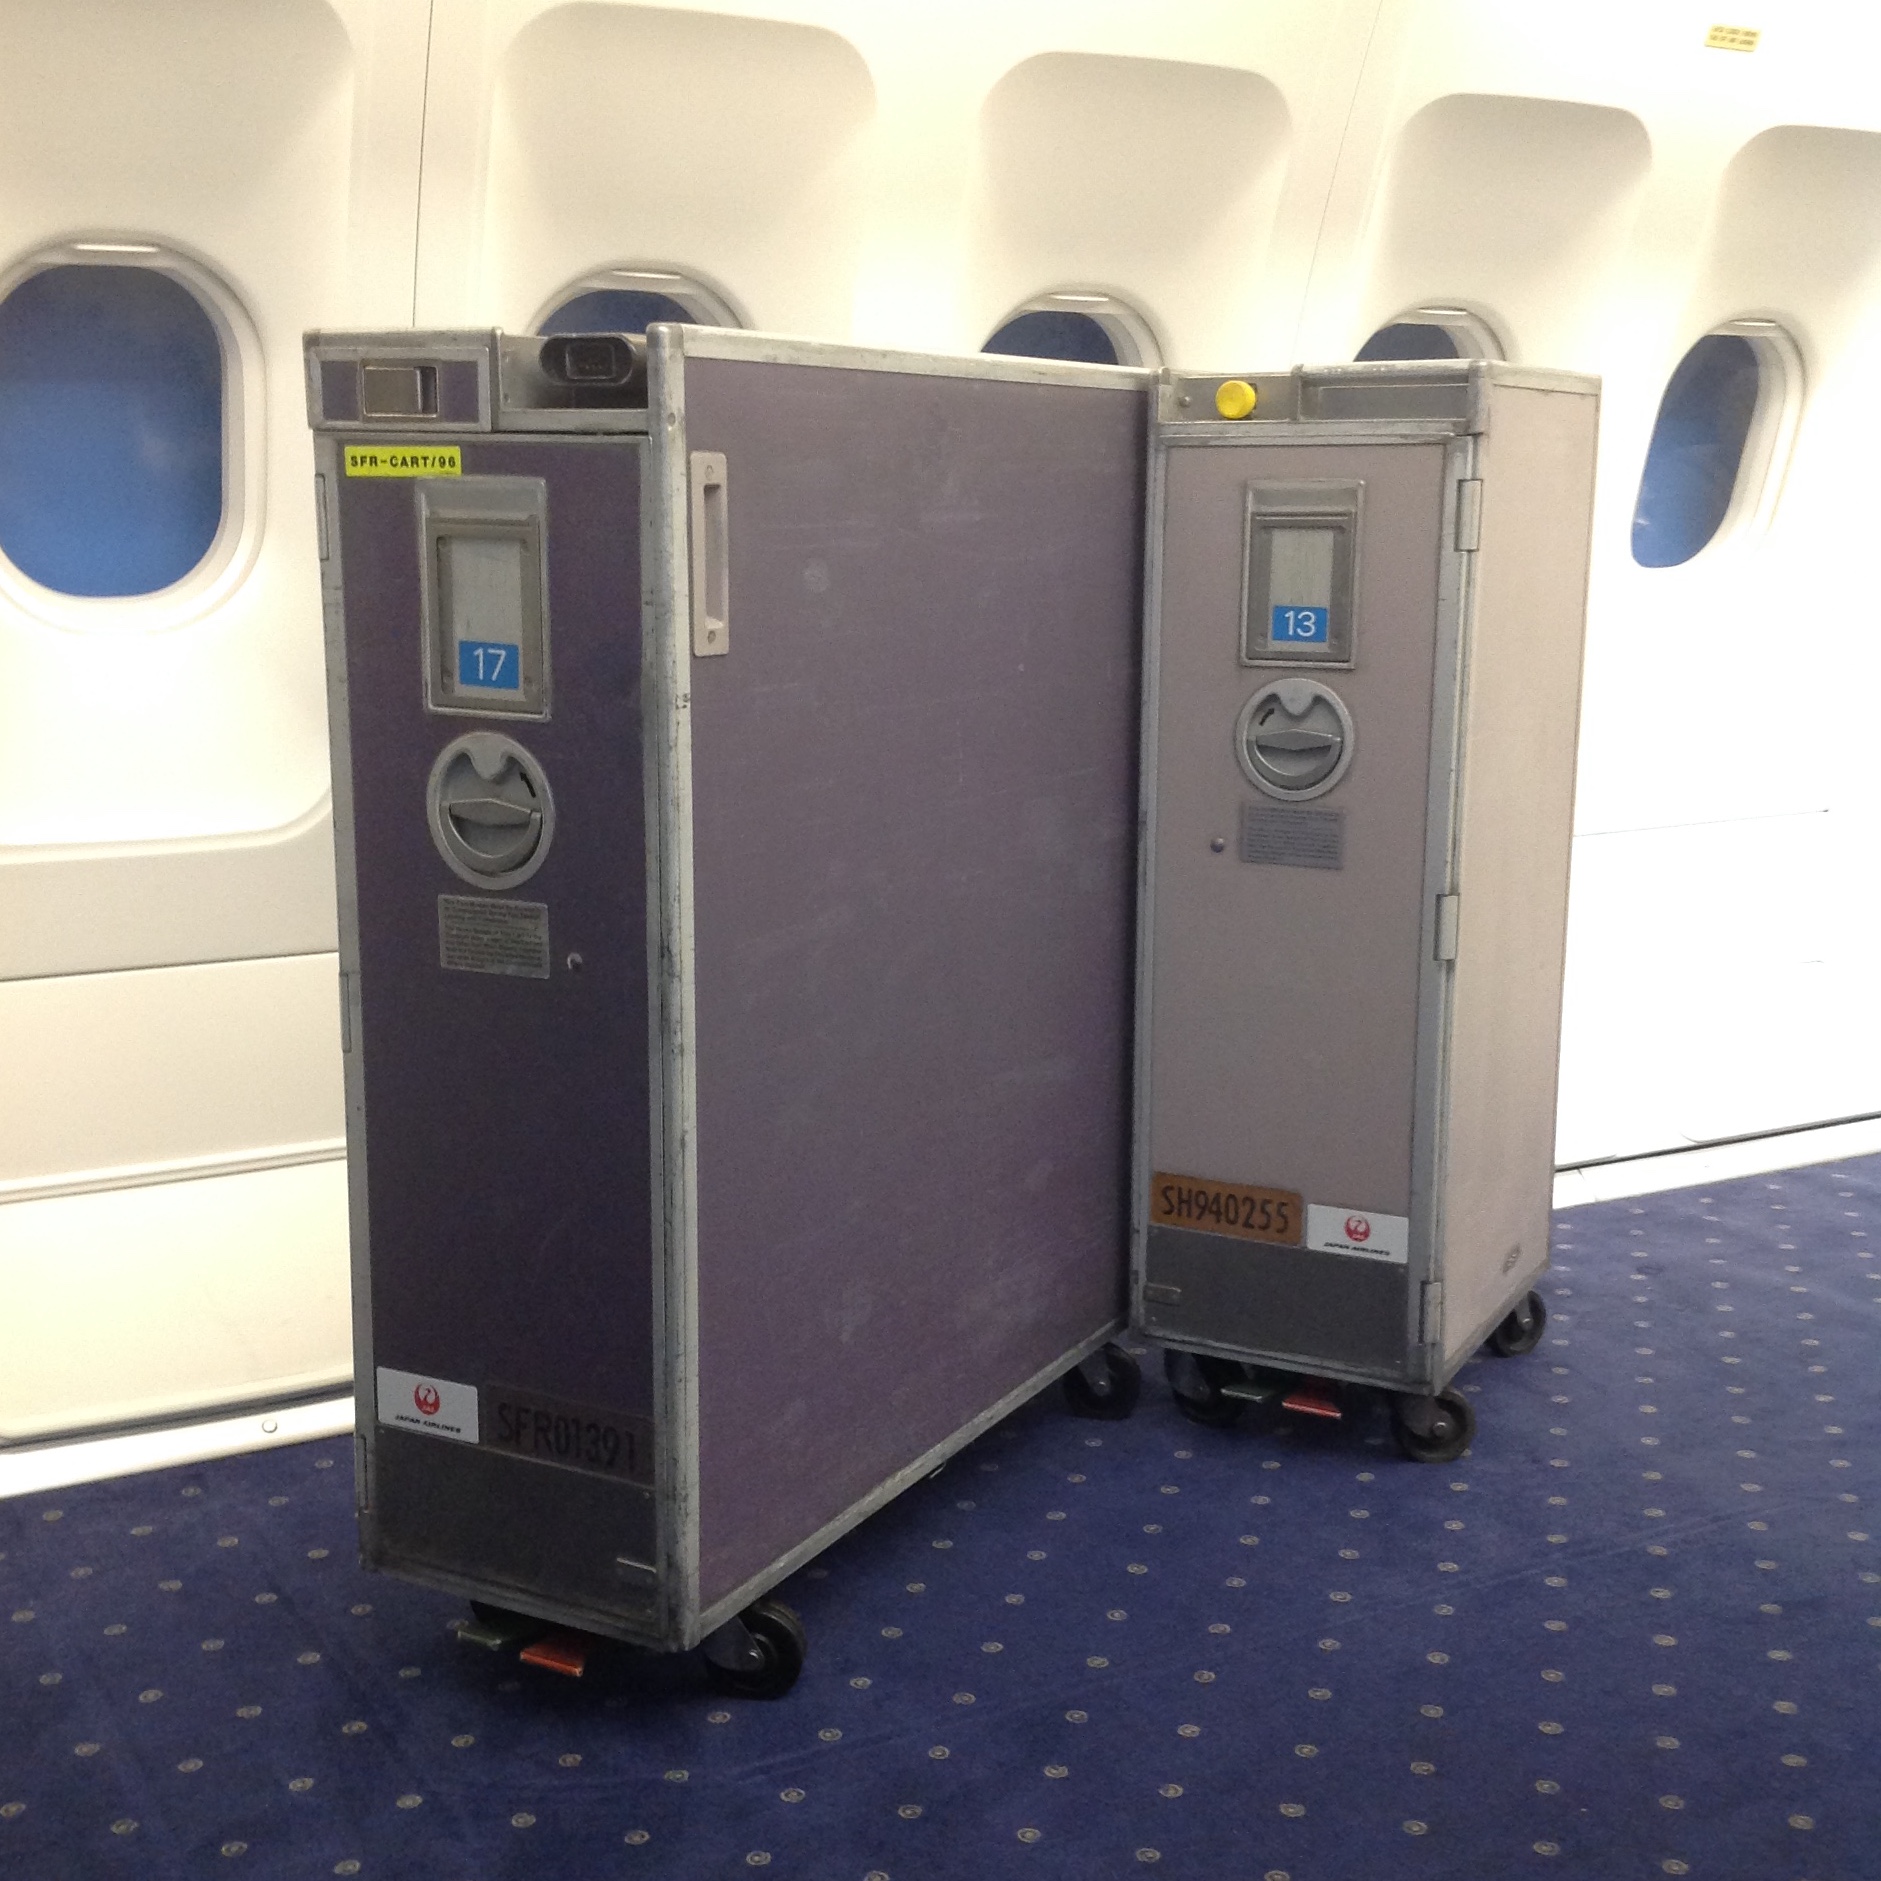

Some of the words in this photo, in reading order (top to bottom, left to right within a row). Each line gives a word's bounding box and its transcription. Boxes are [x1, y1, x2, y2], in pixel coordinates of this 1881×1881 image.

[351, 455, 457, 468] SFR-CART/96
[1284, 610, 1316, 637] 13
[473, 649, 507, 682] 17
[1161, 1185, 1290, 1234] SH940255
[394, 1414, 421, 1425] JAPAN
[423, 1420, 462, 1434] AIRLINES
[497, 1401, 636, 1473] SFR01391
